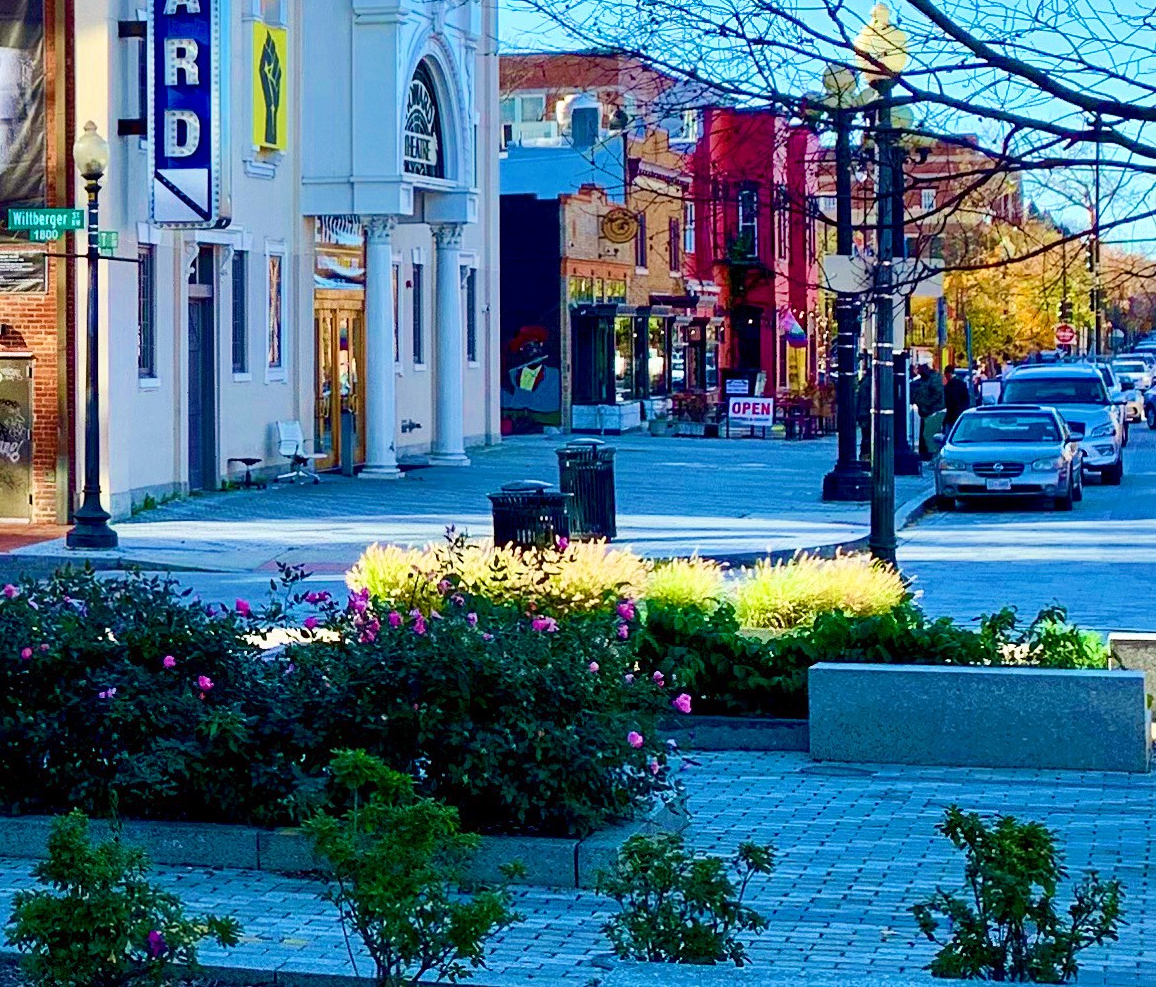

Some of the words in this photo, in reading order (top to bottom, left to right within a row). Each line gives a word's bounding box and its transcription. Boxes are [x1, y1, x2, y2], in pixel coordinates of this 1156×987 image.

[12, 211, 68, 229] Wiltberger
[33, 229, 59, 240] 1800
[732, 402, 771, 415] OPEN
